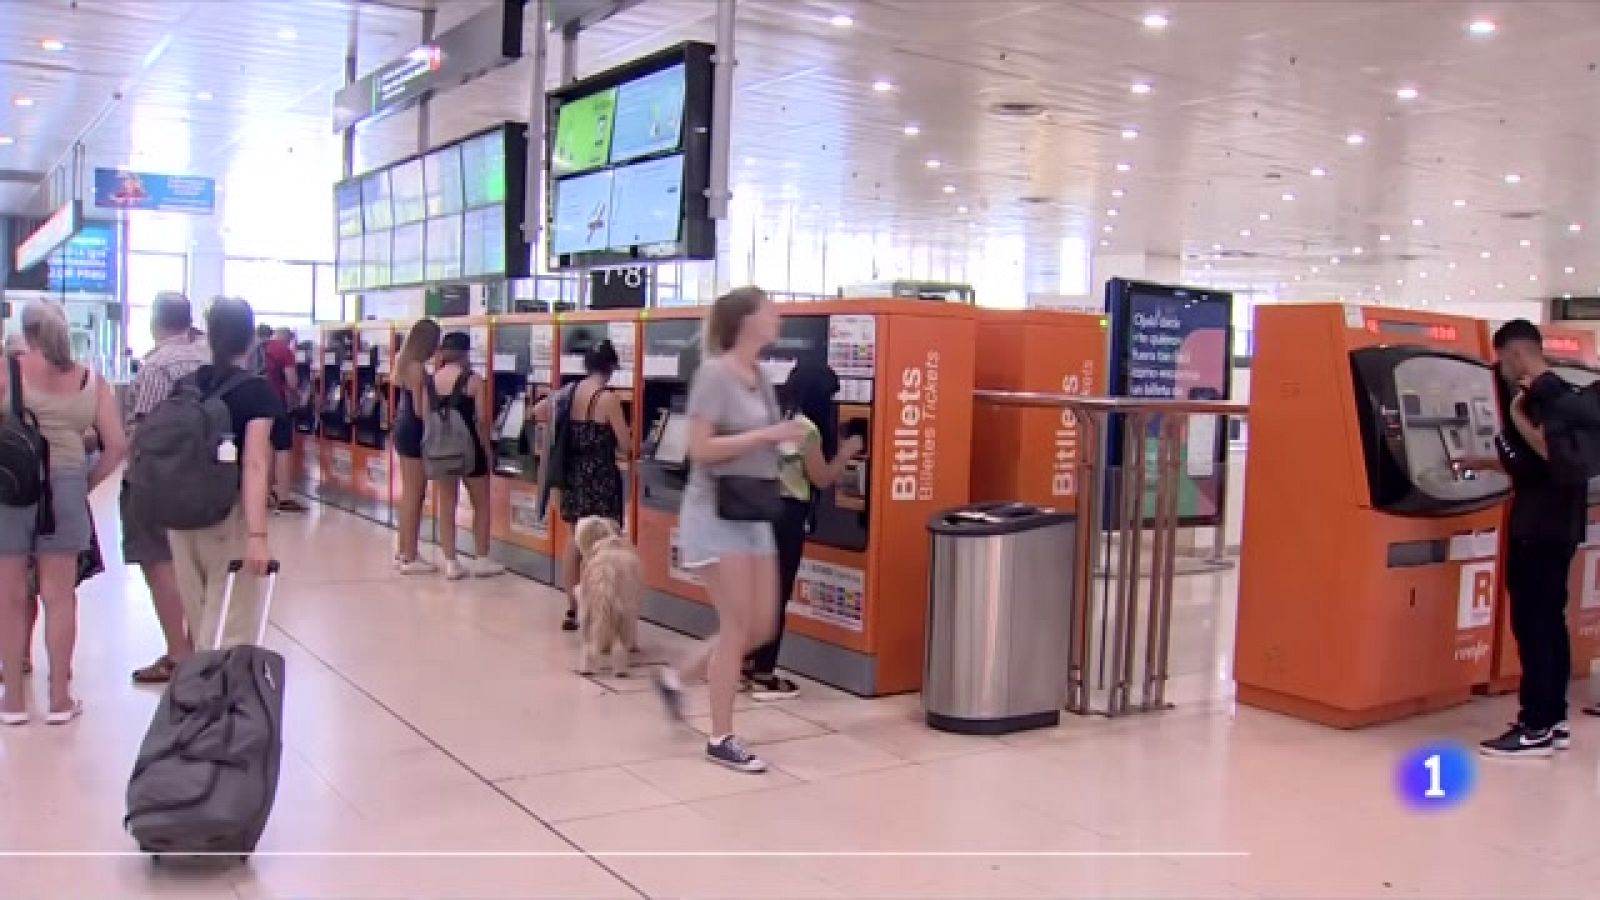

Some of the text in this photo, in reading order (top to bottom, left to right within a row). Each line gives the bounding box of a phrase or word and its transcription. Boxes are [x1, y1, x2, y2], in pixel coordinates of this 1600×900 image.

[892, 367, 921, 500] Bitllets
[919, 350, 940, 500] Billetes Tickets
[1052, 374, 1078, 496] Bitlles
